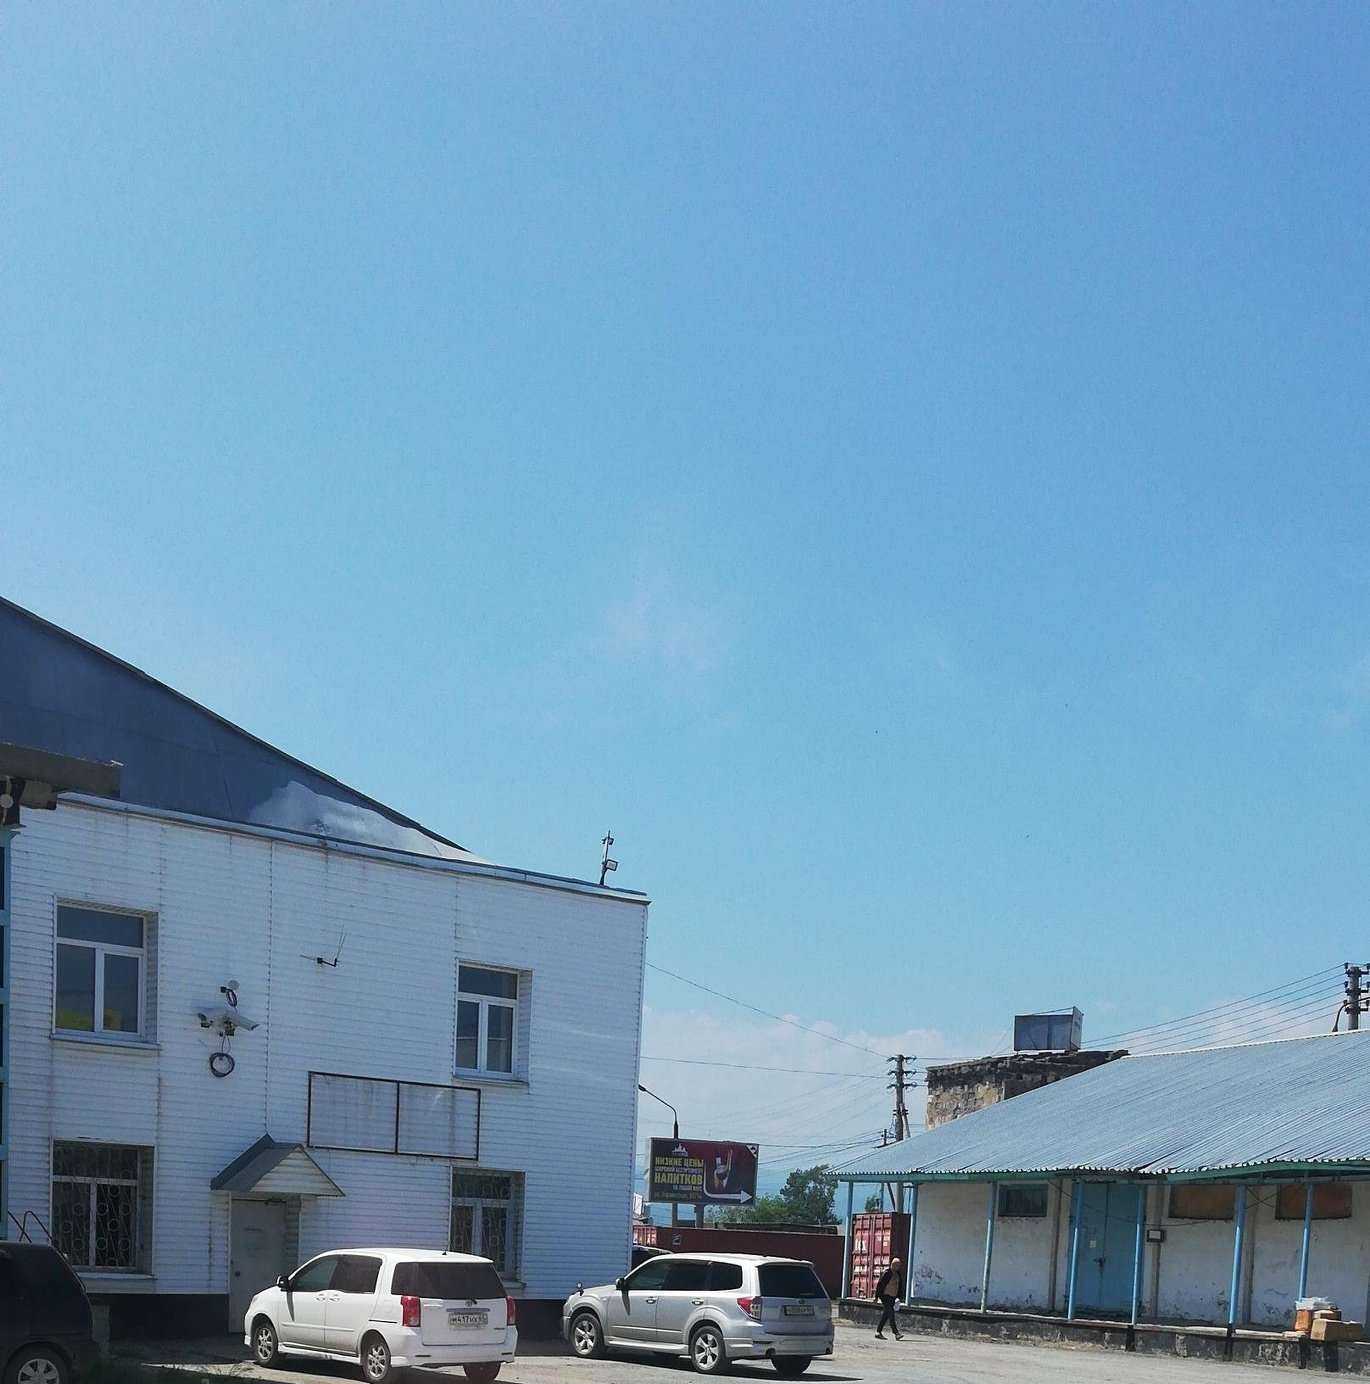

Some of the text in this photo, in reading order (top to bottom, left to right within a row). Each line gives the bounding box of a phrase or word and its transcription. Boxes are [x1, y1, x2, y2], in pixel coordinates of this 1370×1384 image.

[656, 1156, 704, 1168] НИЗКИЕ ЦЕНЫ
[655, 1172, 703, 1185] НАПИТКОВ
